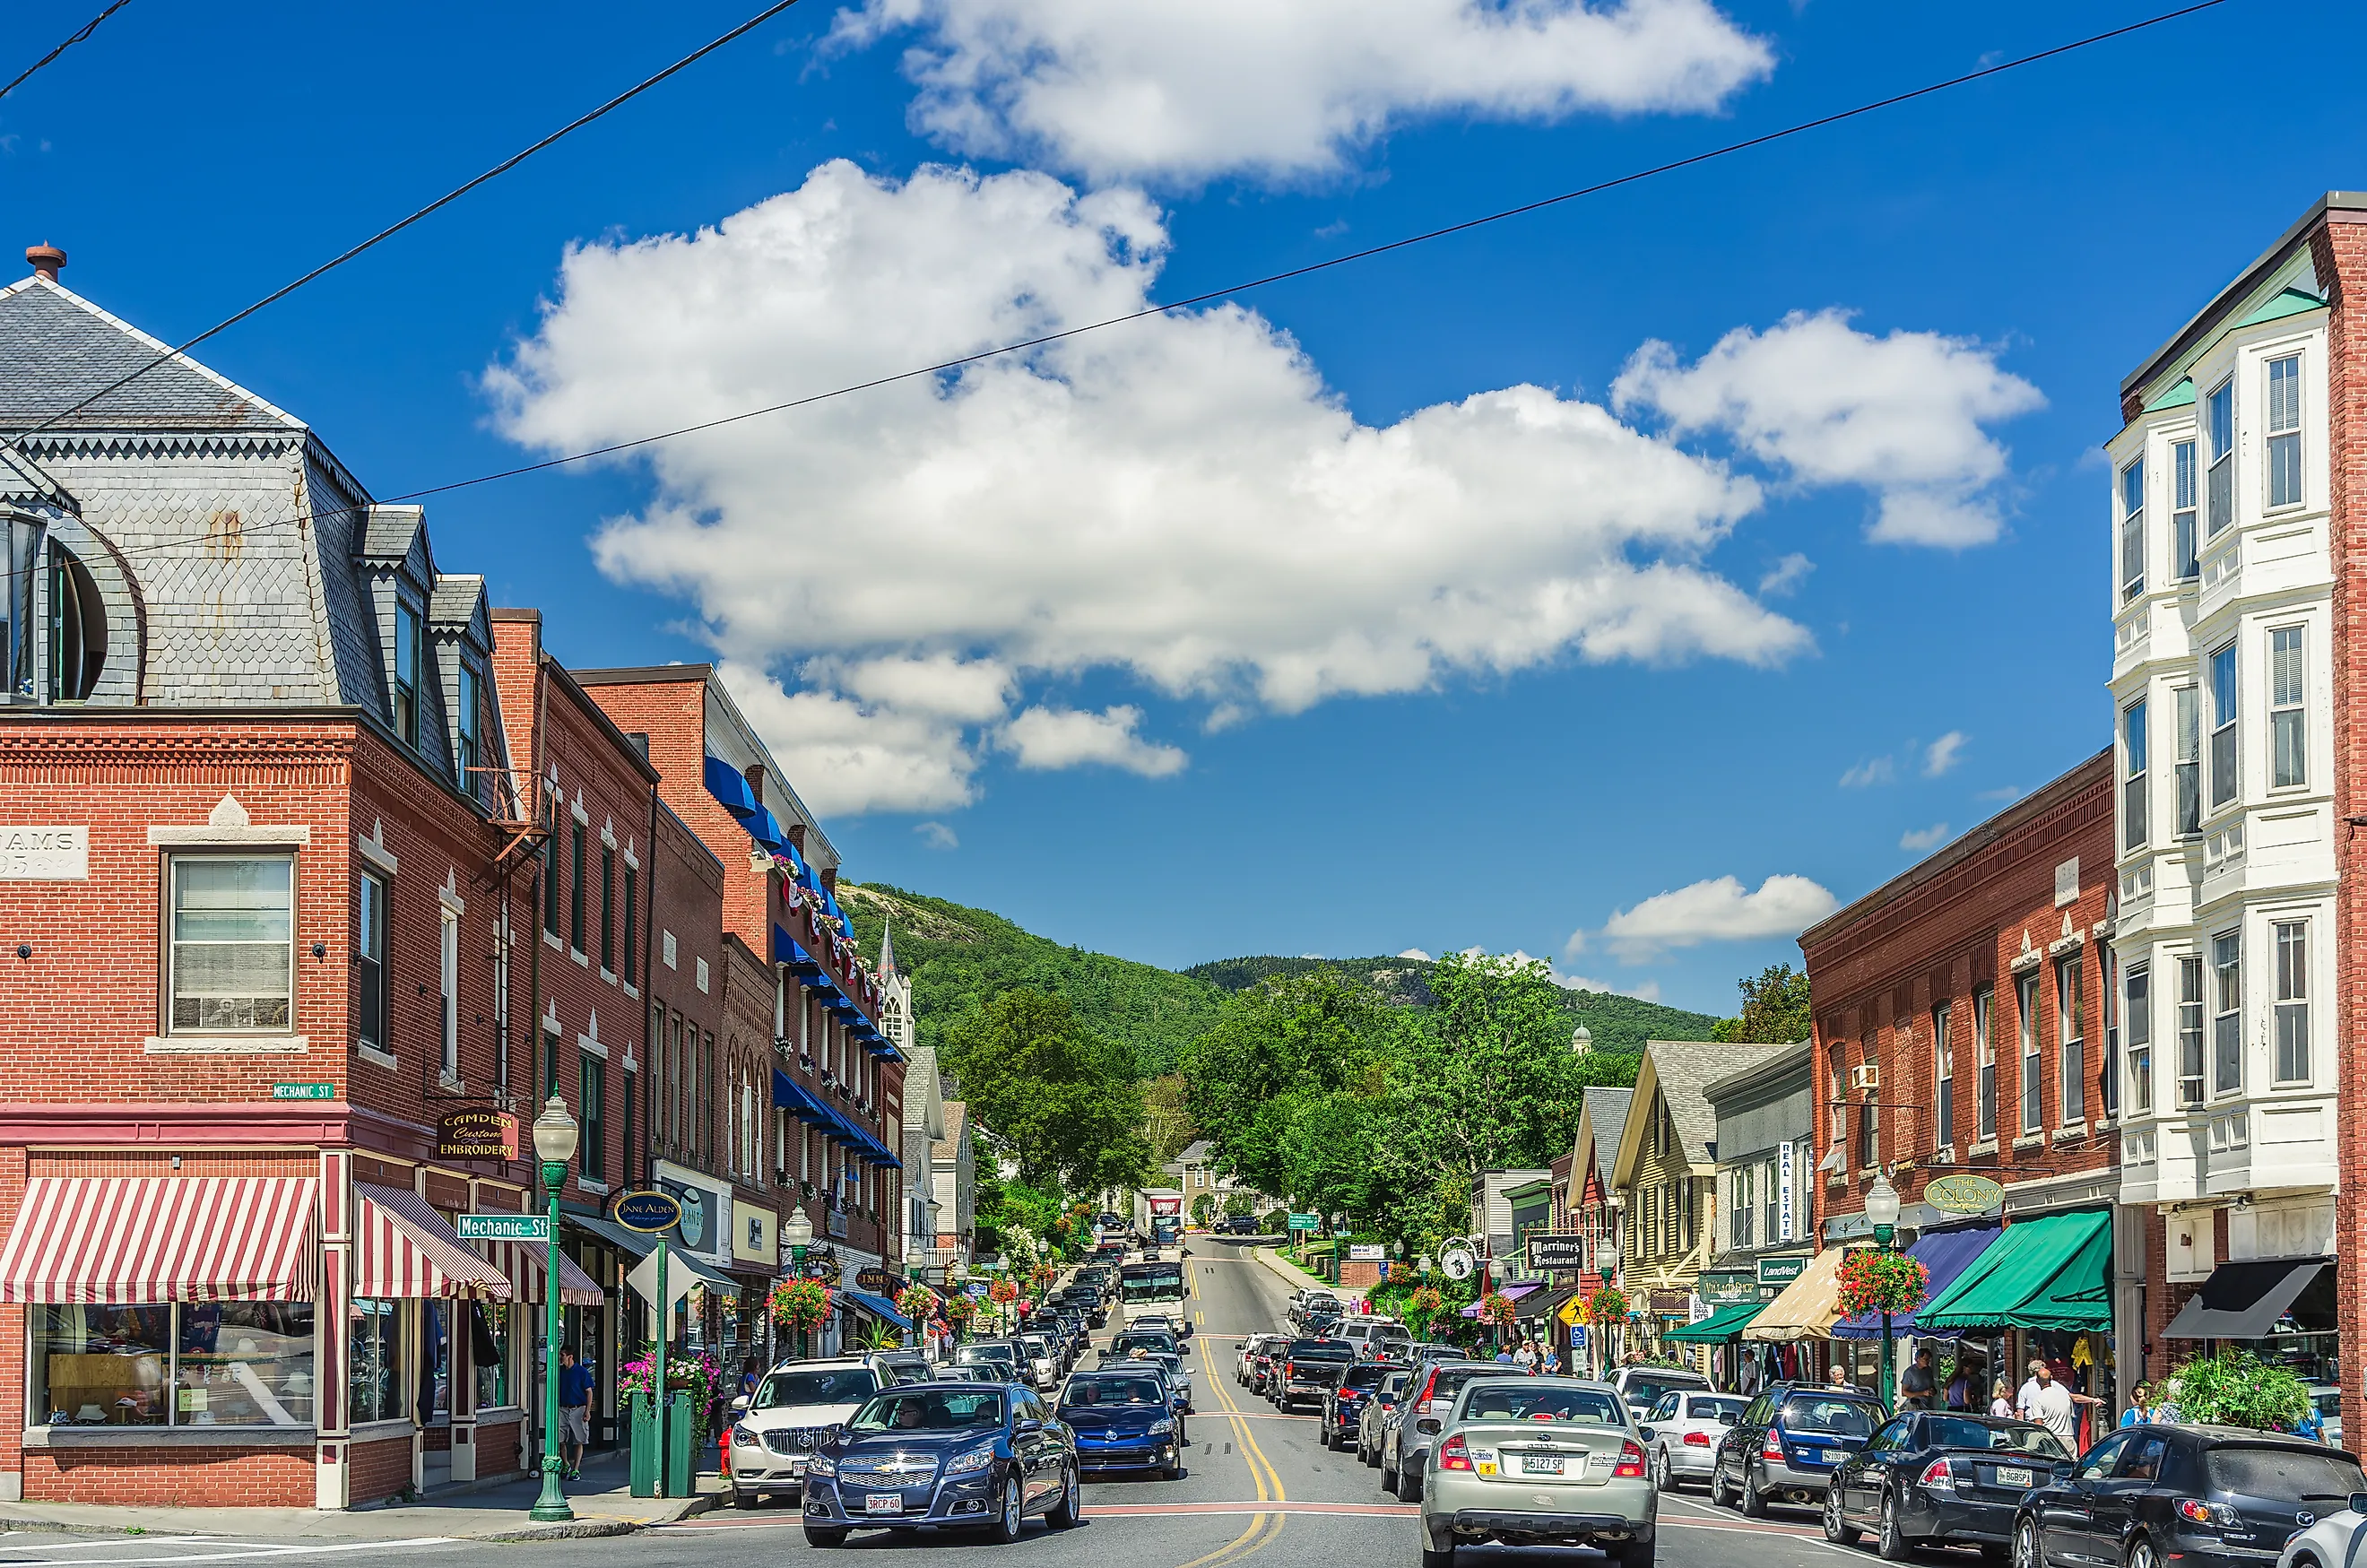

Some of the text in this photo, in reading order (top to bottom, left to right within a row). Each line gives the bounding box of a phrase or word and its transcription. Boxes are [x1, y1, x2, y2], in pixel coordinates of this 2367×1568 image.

[0, 833, 82, 850] AMS.
[273, 1086, 330, 1097] MECHANIC ST
[444, 1113, 513, 1130] CAMDEN
[453, 1127, 502, 1139] Custom
[440, 1144, 514, 1157] EMBROIDERY
[1954, 1179, 1976, 1187] THE
[1782, 1144, 1790, 1236] REAL ESTATE
[1929, 1186, 2001, 1202] COLONY
[620, 1203, 675, 1214] JANE ALDEN
[461, 1217, 546, 1236] Mechanic St
[1530, 1240, 1581, 1255] Marriner's
[1533, 1254, 1578, 1267] Restaurant
[1763, 1266, 1800, 1277] LandVest
[862, 1275, 884, 1283] INN
[1530, 1459, 1563, 1469] 5127 SP
[868, 1498, 900, 1510] 3RCP 60
